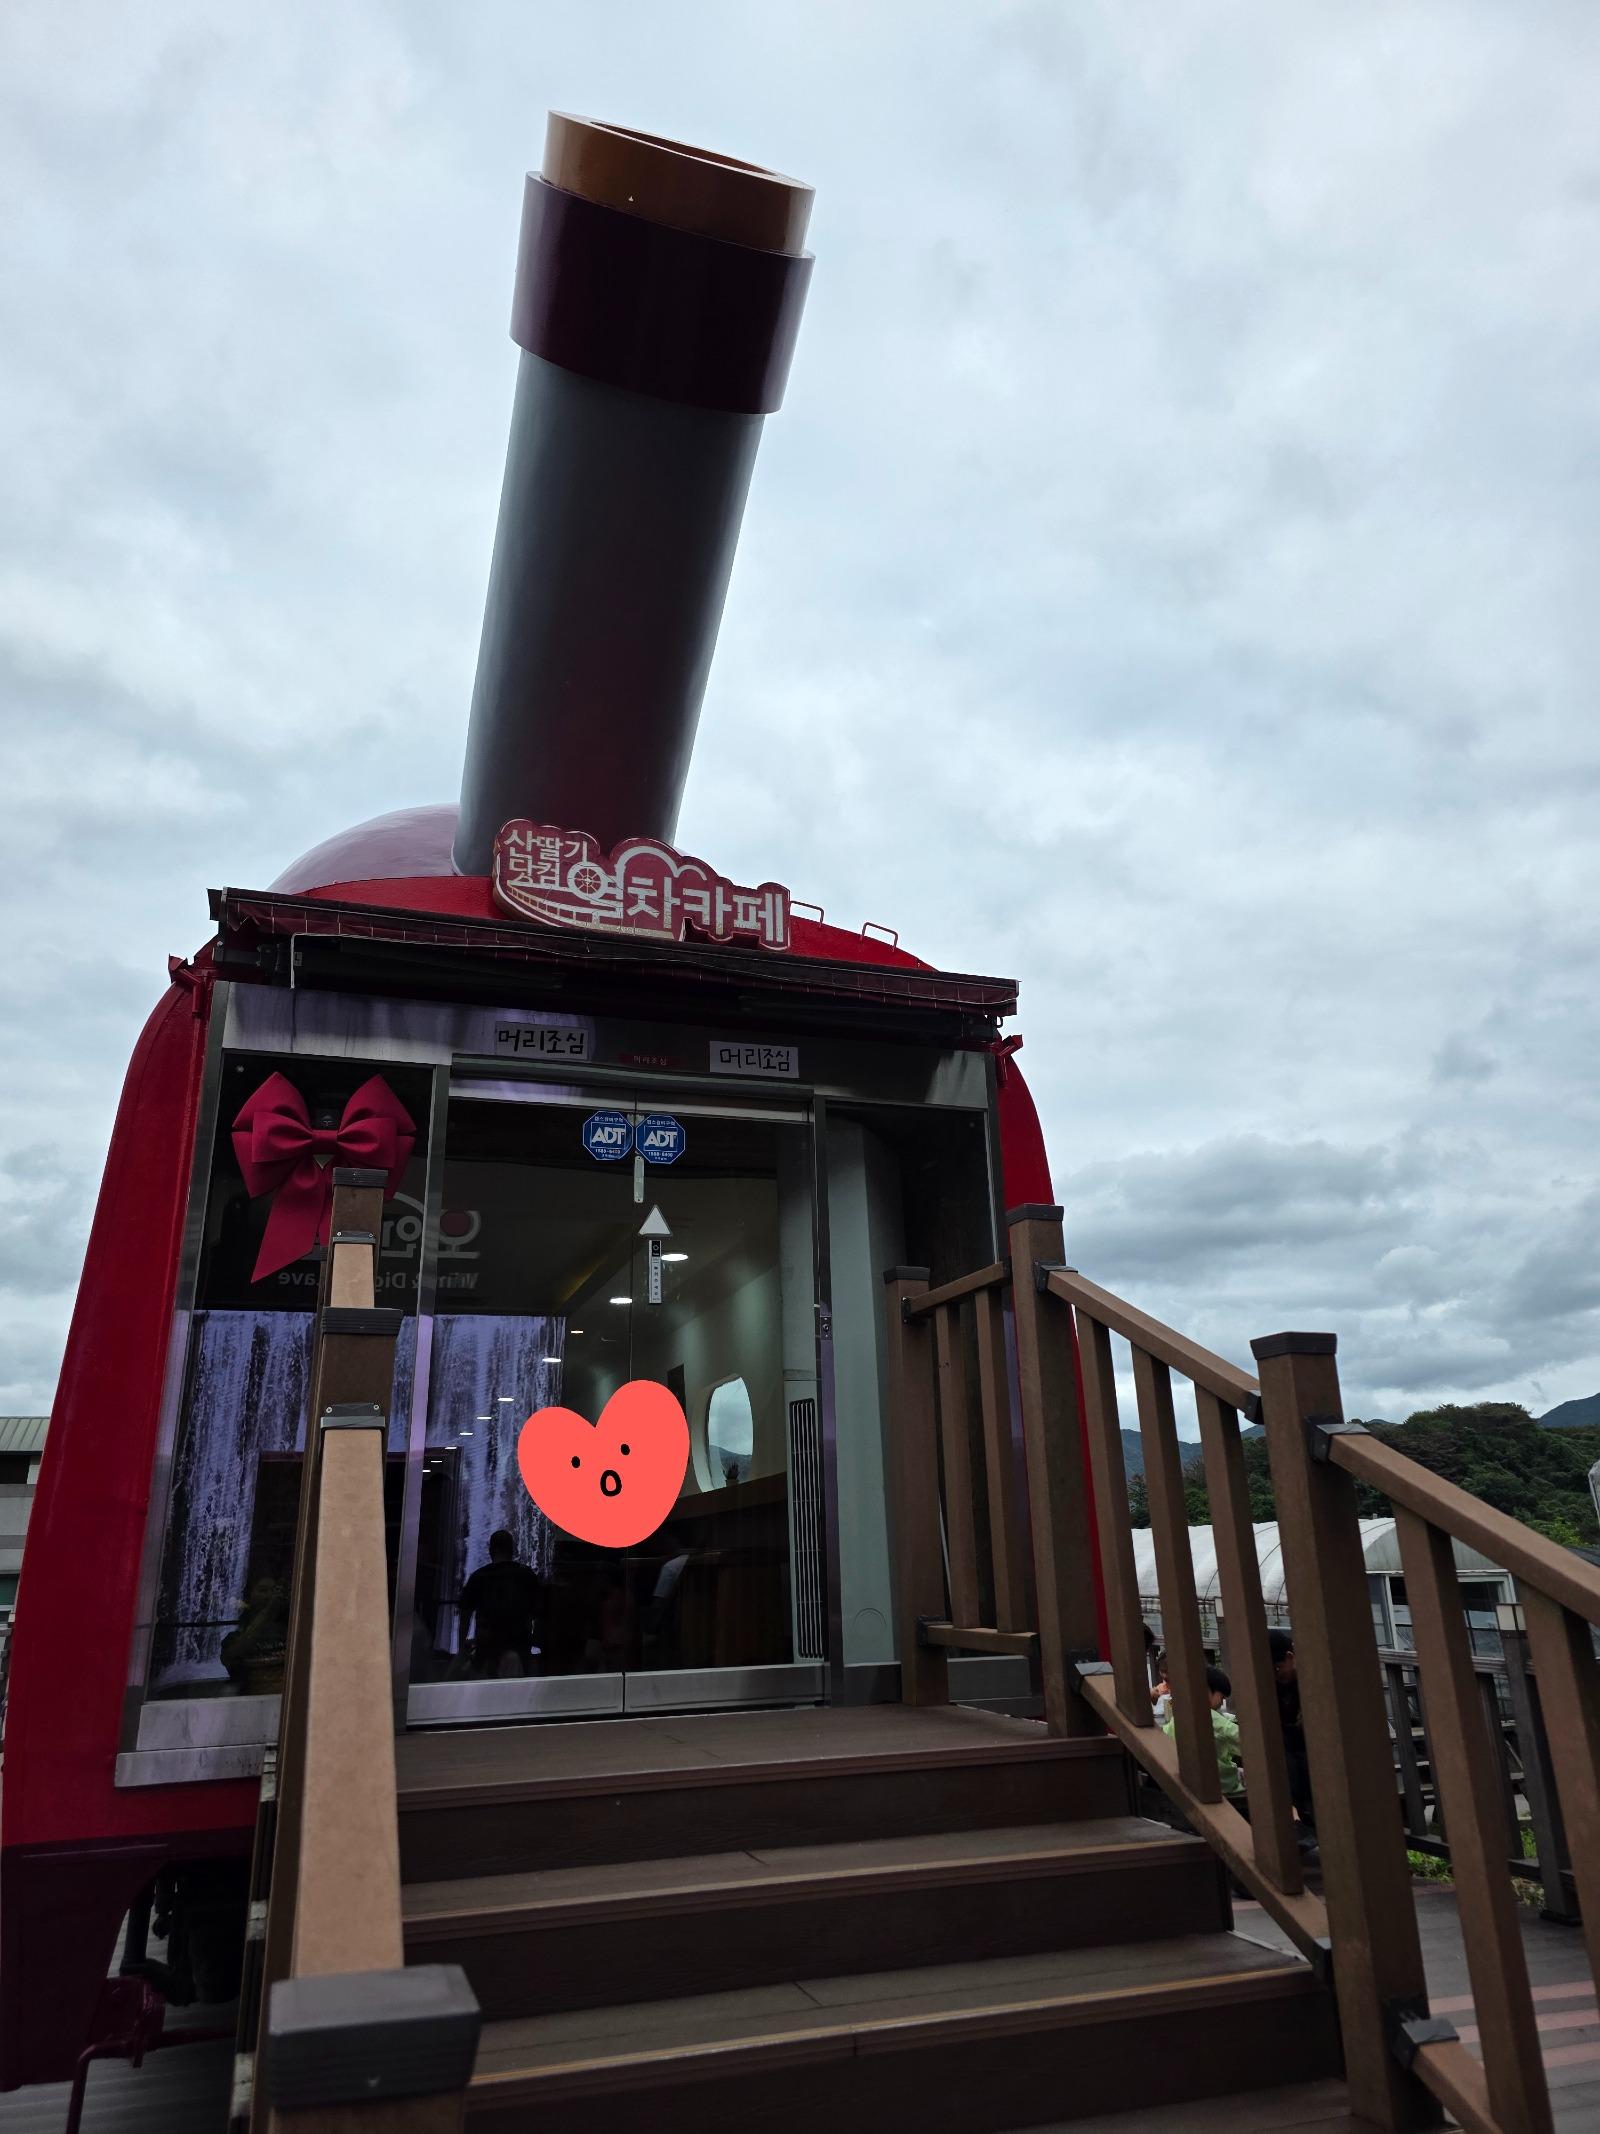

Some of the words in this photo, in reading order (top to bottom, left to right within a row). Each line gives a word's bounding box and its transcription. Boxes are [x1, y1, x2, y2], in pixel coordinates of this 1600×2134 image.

[503, 829, 588, 863] 산딸기
[566, 856, 784, 942] 열차카페
[498, 1028, 585, 1055] 머리조심
[719, 1048, 790, 1072] 머리조심
[591, 1126, 626, 1145] ADT
[643, 1129, 678, 1148] ADT
